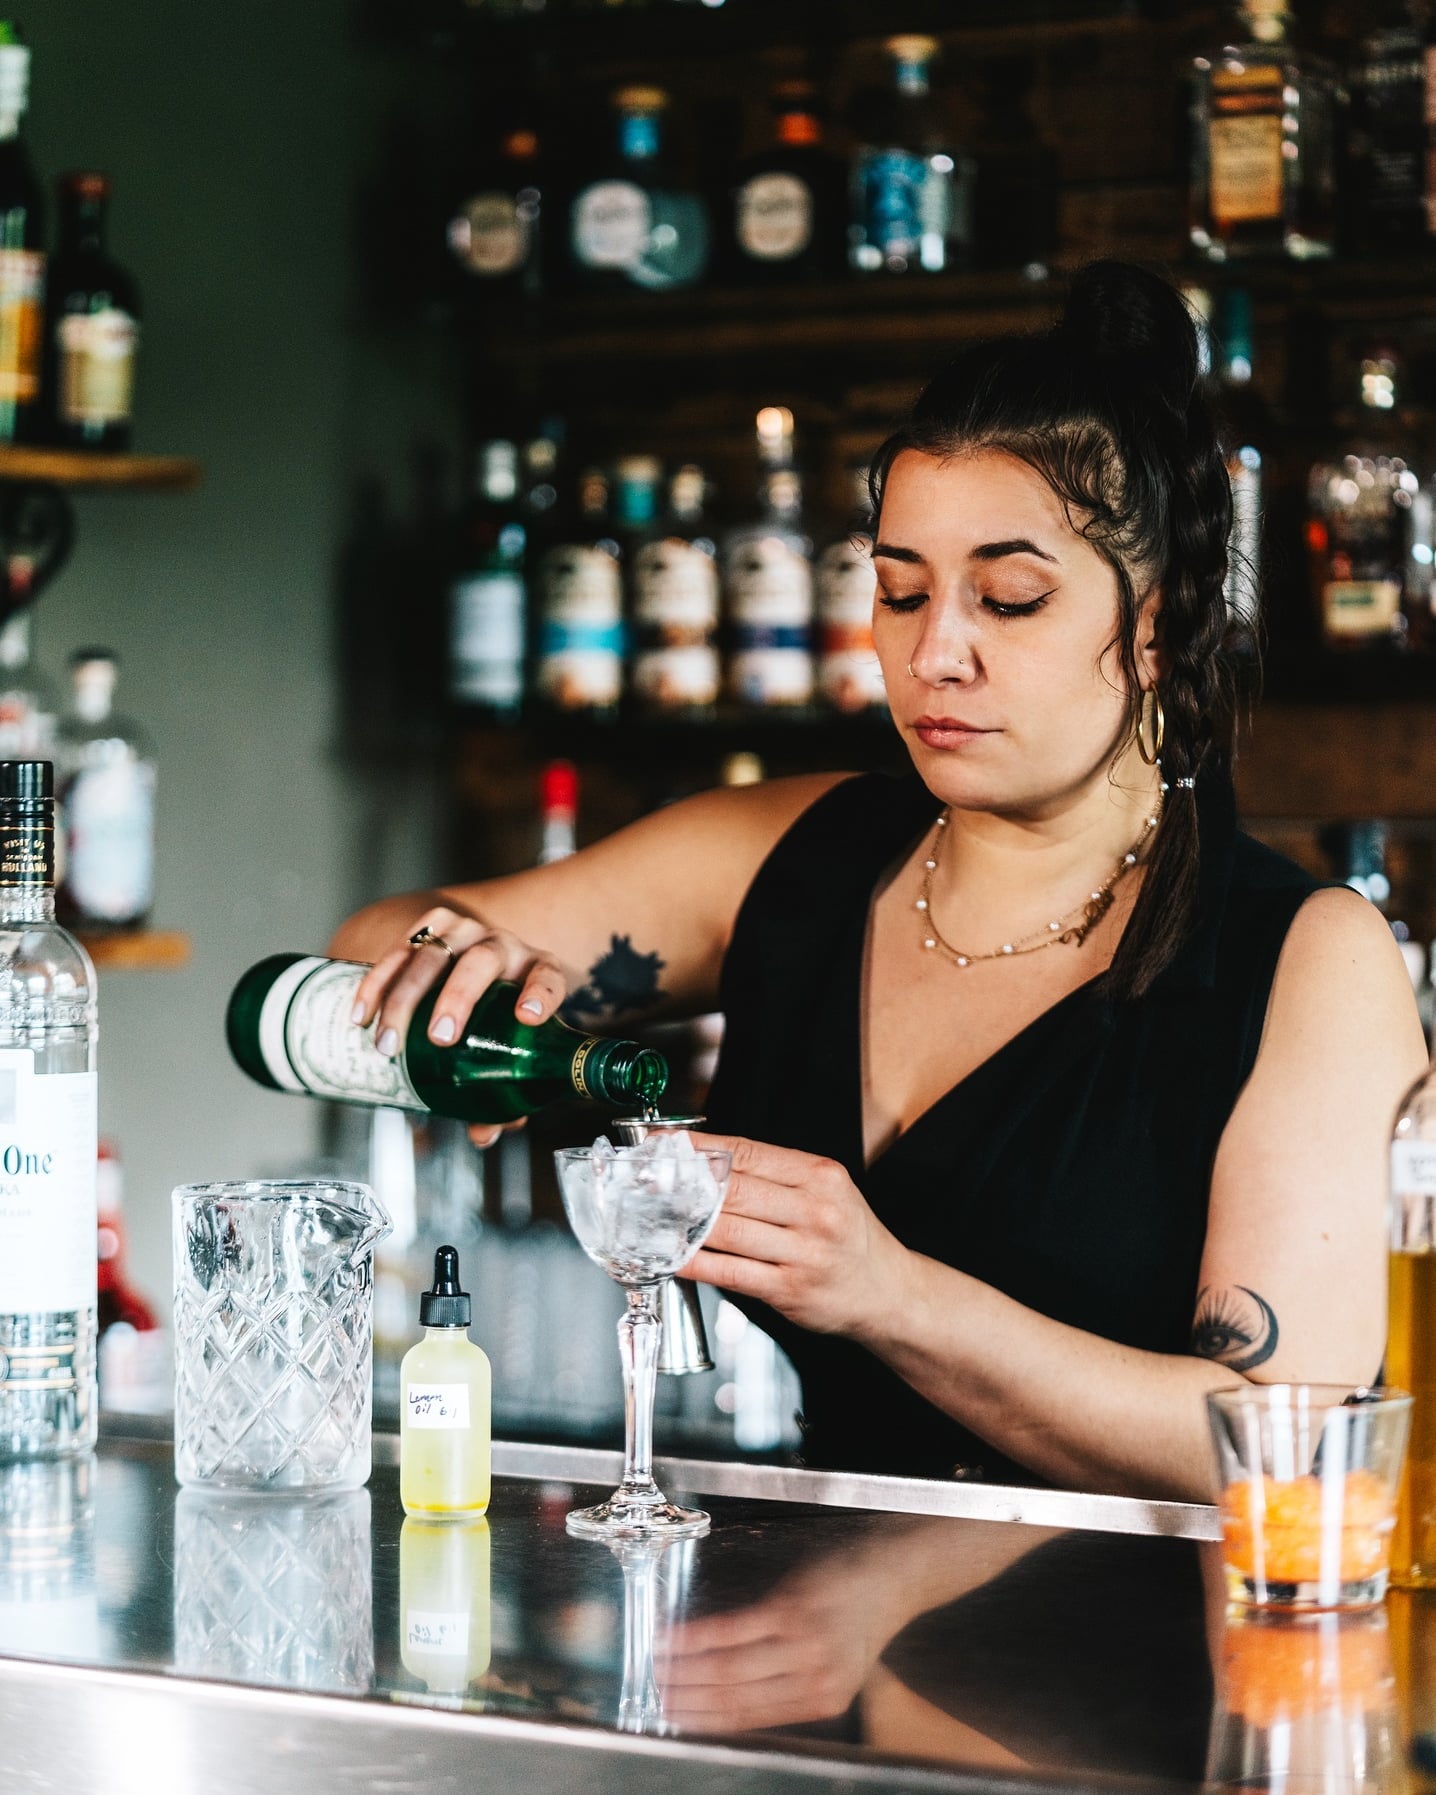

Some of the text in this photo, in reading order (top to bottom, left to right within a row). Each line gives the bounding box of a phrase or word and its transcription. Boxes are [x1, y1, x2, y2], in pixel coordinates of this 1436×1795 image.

[3, 839, 45, 850] VISIT US
[1, 862, 47, 873] HOLLAND
[575, 1050, 586, 1090] DOLIN
[3, 1144, 52, 1176] One
